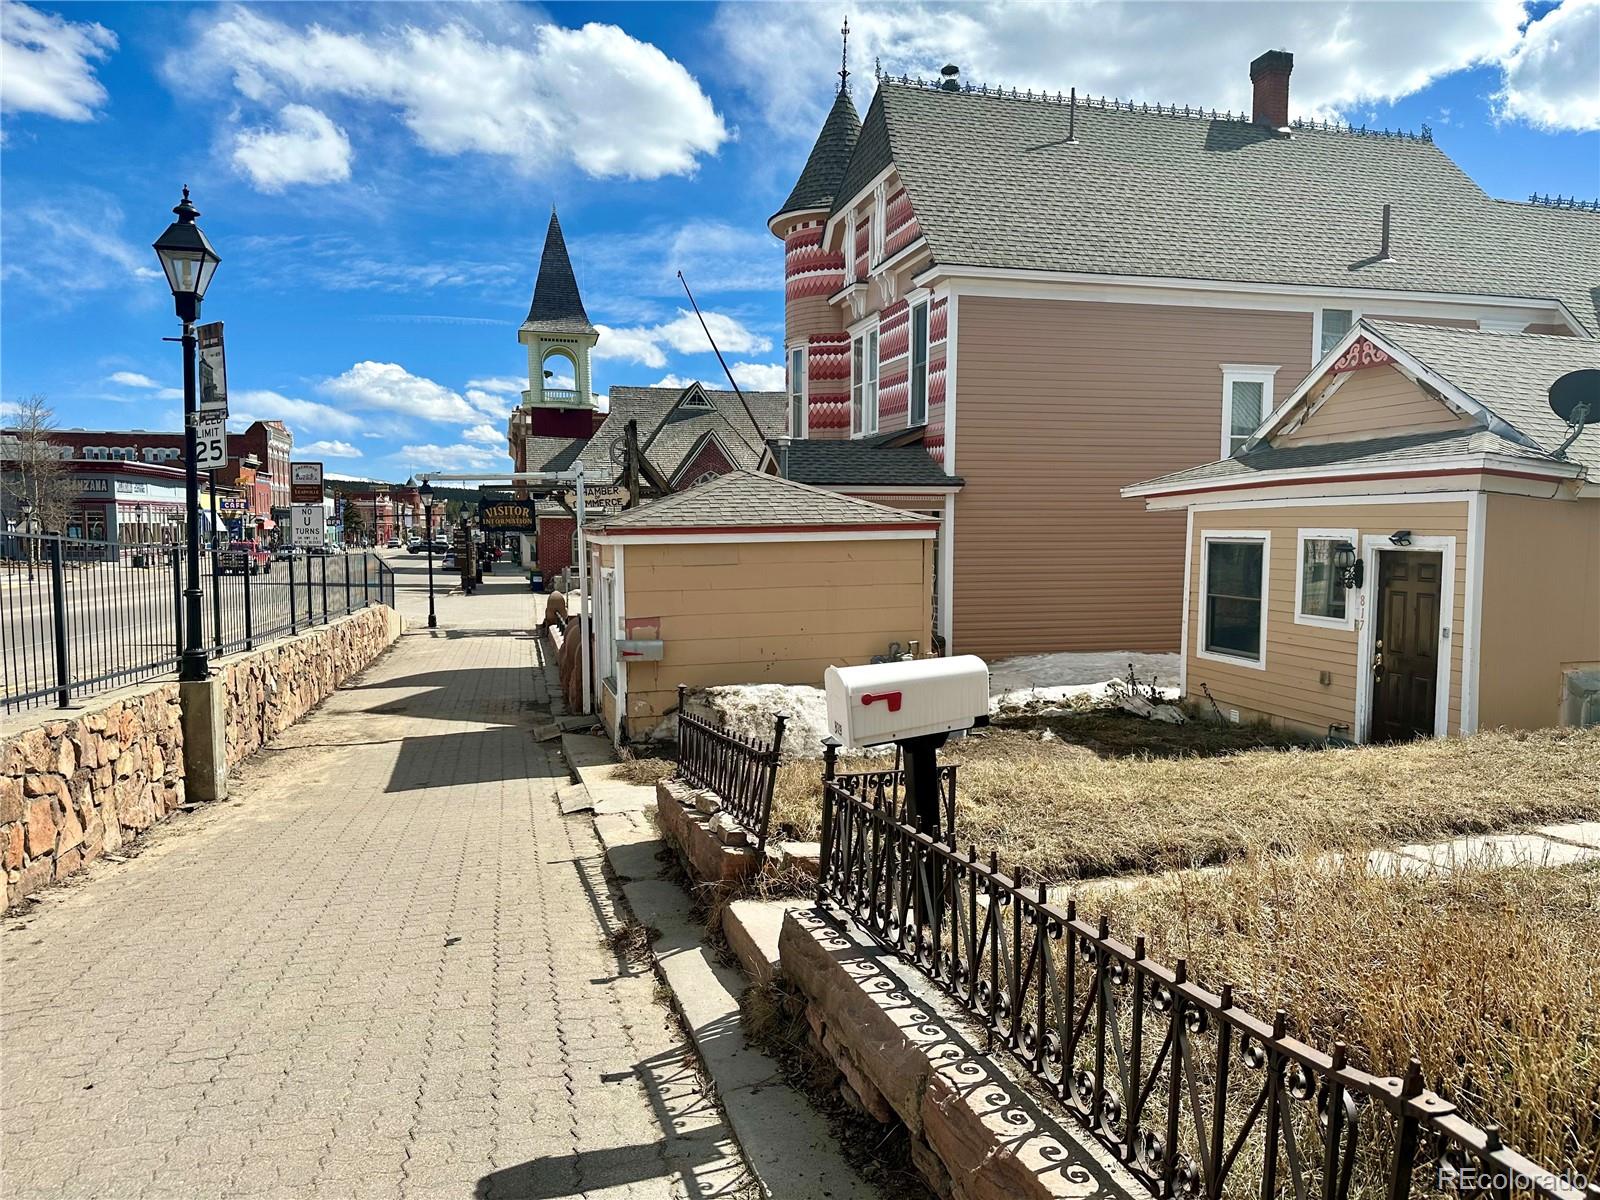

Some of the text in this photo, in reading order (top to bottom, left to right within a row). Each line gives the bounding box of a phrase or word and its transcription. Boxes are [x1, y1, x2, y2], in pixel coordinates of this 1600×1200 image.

[197, 417, 222, 427] PEED
[196, 427, 219, 439] LIMIT
[196, 439, 223, 462] 25
[573, 496, 624, 508] CMMERCE
[485, 505, 529, 517] VISITOR
[304, 517, 311, 526] U
